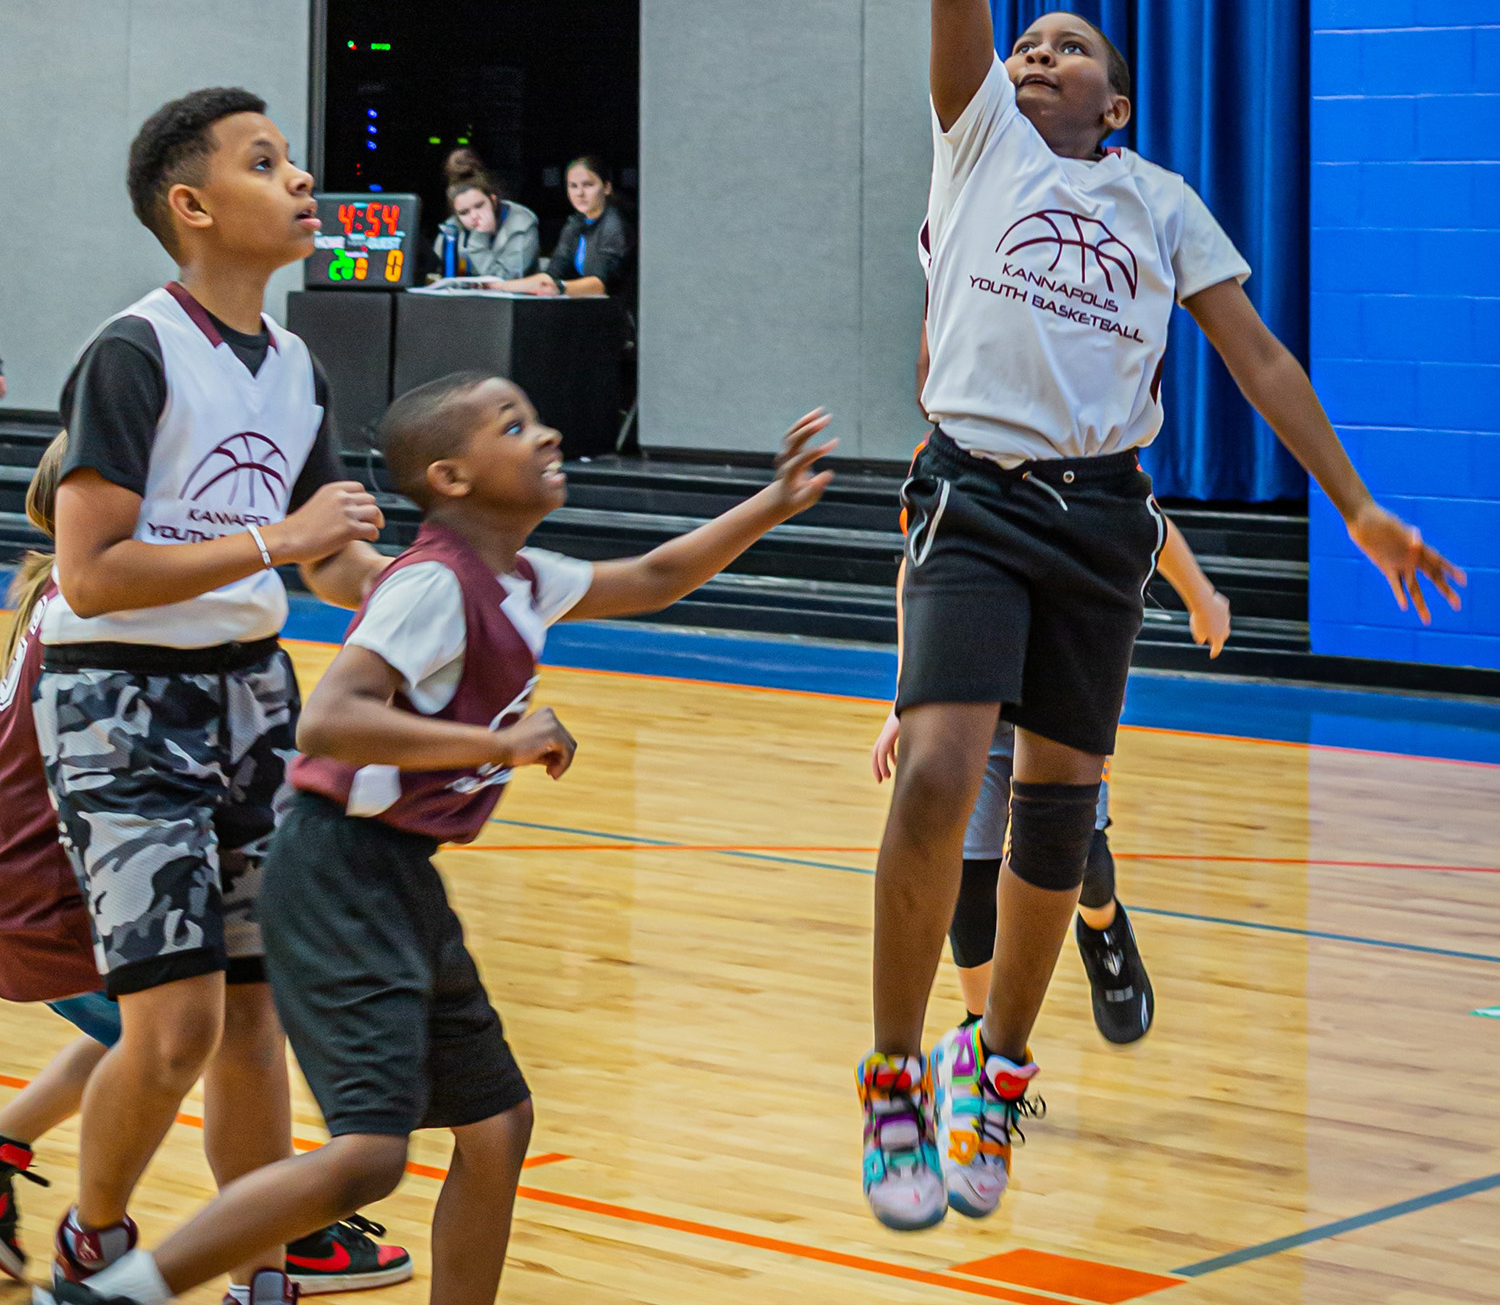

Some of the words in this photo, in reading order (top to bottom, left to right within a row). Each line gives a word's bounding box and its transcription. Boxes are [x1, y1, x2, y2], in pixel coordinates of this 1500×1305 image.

[338, 201, 400, 238] 4:54
[969, 274, 1029, 303] YOUTH
[1031, 293, 1144, 344] BASKETBALL
[1002, 262, 1119, 313] KANNAPOLIS
